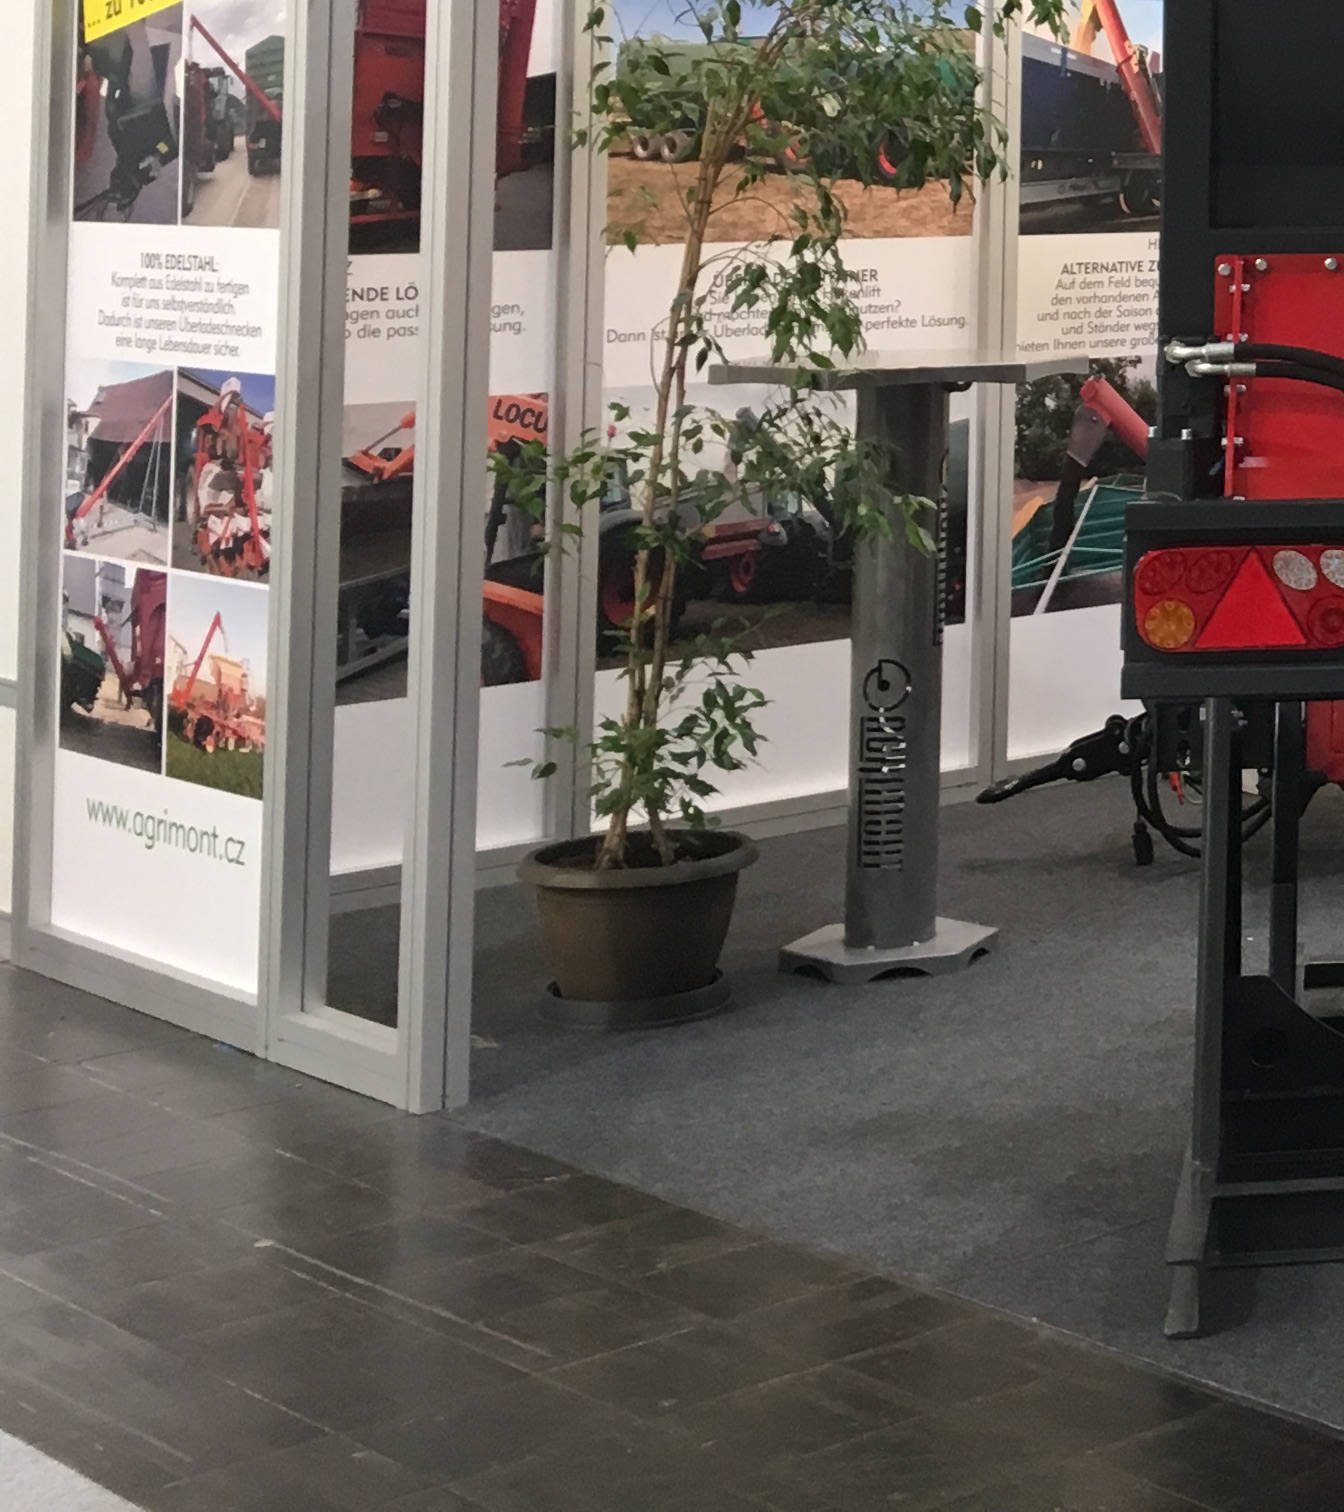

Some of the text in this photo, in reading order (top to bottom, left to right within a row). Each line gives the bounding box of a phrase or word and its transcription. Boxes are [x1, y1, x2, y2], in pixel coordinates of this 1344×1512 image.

[140, 252, 163, 269] 100%
[1061, 261, 1144, 275] ALTERNATIVE
[1055, 279, 1076, 290] Auf
[1079, 277, 1104, 289] dem
[1108, 276, 1131, 288] Feld
[1051, 295, 1072, 306] den
[1076, 292, 1149, 304] vorhandenen
[1037, 305, 1152, 322] und nach der Saison
[356, 324, 381, 339] die
[606, 329, 646, 344] Dann
[651, 328, 666, 341] ist
[865, 316, 917, 332] perfekte
[921, 314, 969, 330] Lösung.
[1062, 323, 1083, 336] und
[1087, 320, 1130, 334] Ständer
[1054, 339, 1086, 351] Ihnen
[1089, 336, 1126, 349] unsere
[87, 798, 246, 866] www.agrimont.cz
